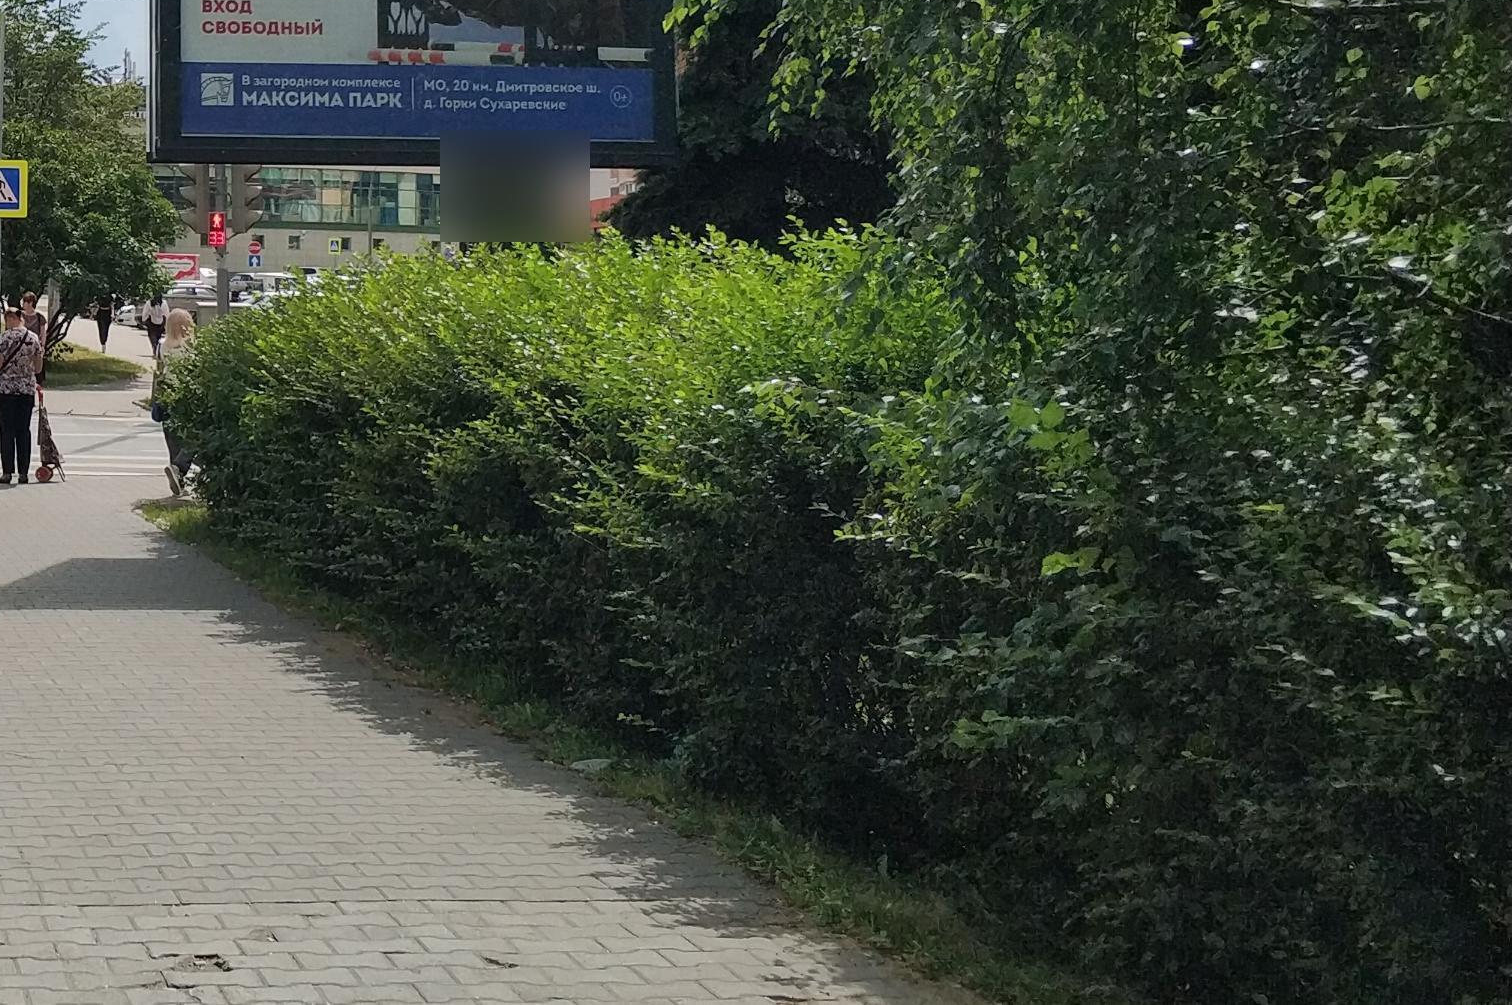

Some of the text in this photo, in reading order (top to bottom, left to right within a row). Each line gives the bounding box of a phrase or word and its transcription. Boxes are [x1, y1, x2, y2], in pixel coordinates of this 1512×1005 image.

[202, 0, 253, 14] ВХОД
[202, 18, 324, 36] СВОБОДНЫЙ
[242, 75, 401, 89] В загородном комплексе
[453, 80, 469, 91] 20
[496, 81, 583, 95] Дмитровское
[586, 85, 601, 93] ш.
[242, 91, 403, 108] МАКСИМА ПАРК
[440, 97, 476, 112] Горки
[480, 98, 568, 112] Сухаревские
